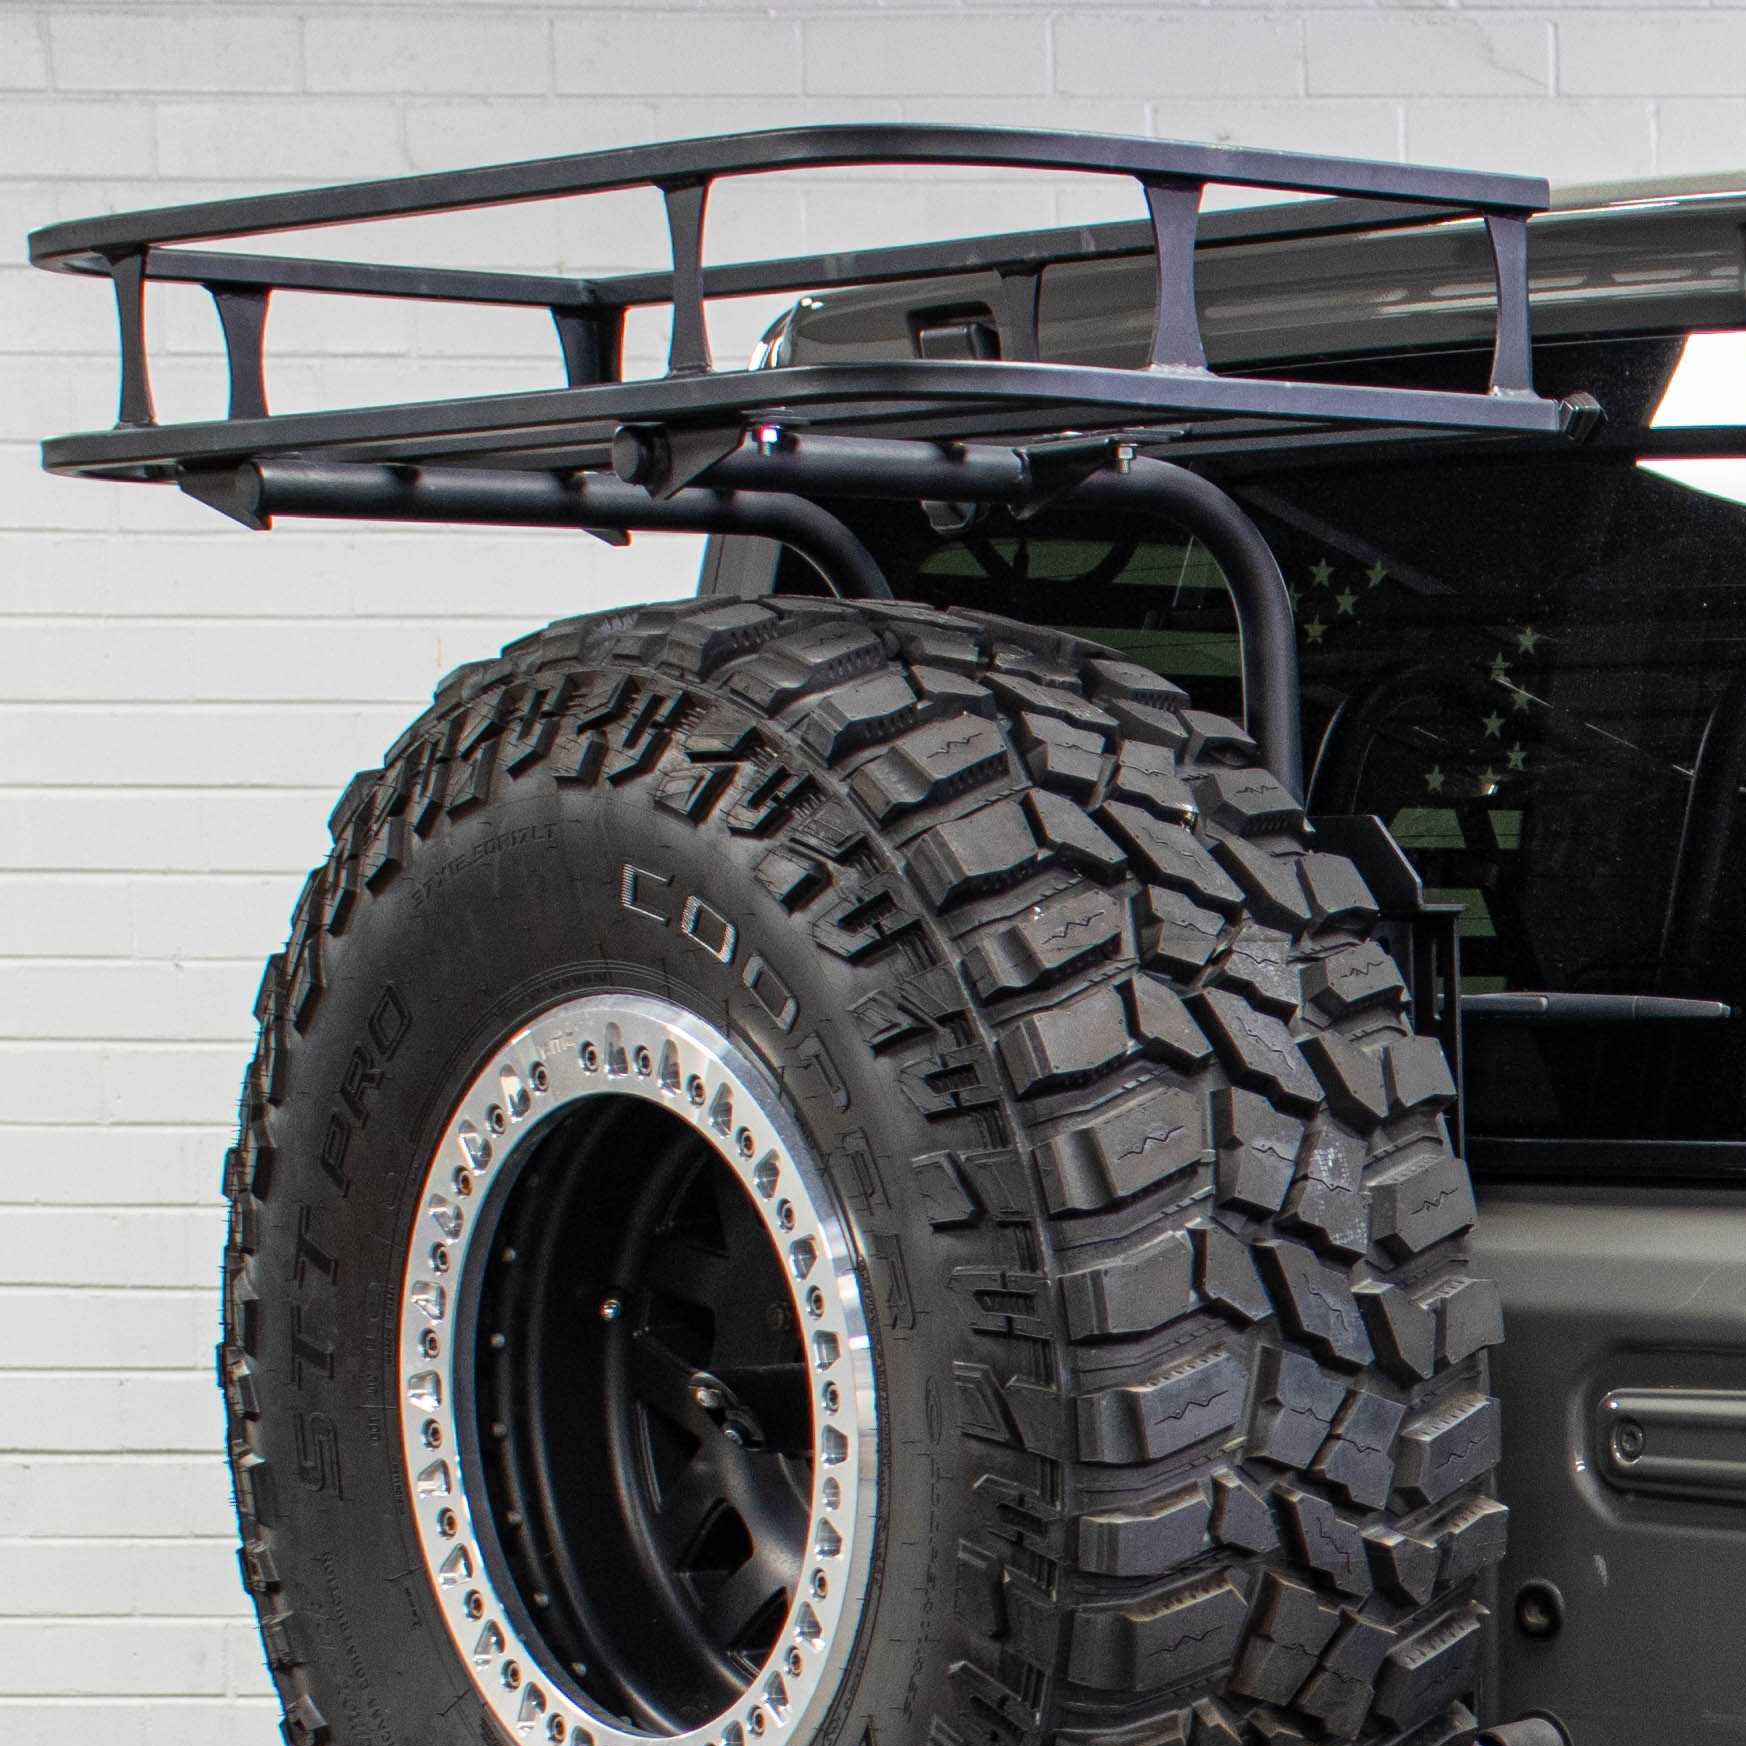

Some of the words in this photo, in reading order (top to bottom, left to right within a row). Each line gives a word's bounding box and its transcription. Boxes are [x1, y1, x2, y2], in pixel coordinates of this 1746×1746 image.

[292, 1203, 343, 1500] STT
[320, 983, 413, 1197] PRO
[620, 863, 914, 1331] COOPER
